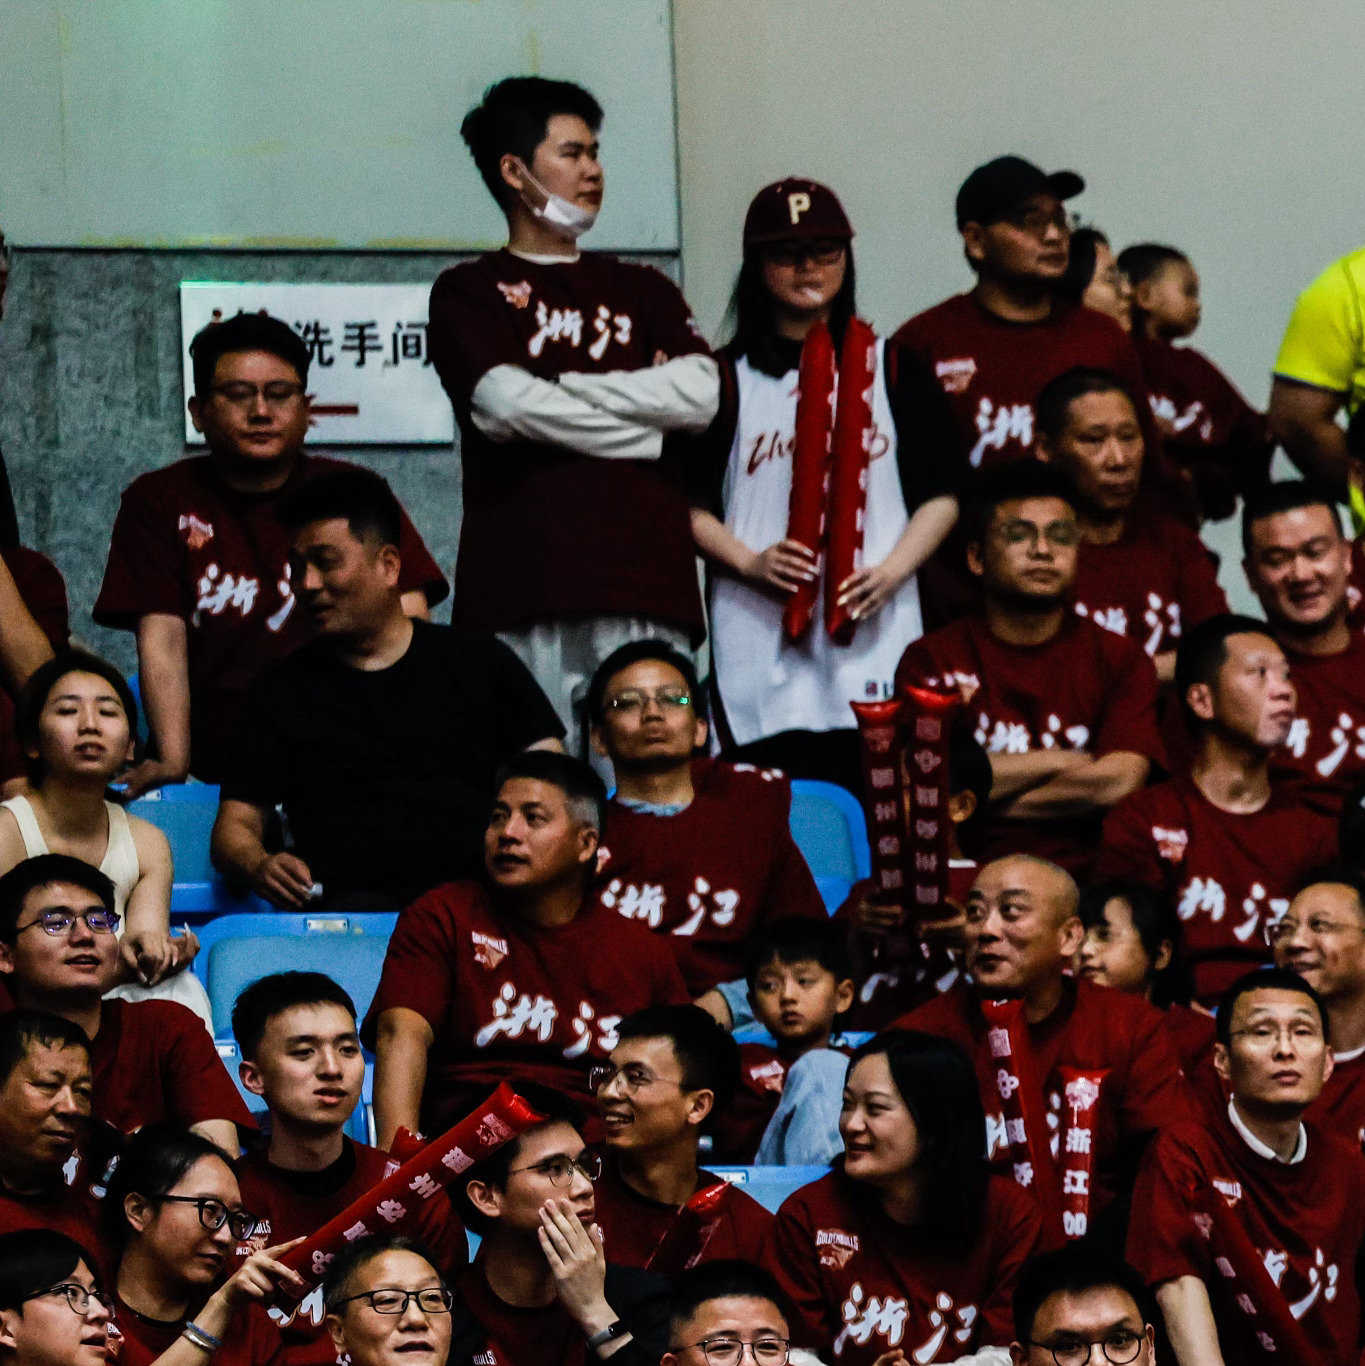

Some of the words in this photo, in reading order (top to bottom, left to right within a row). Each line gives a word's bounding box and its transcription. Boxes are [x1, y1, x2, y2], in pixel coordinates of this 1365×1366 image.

[788, 193, 812, 225] P
[970, 397, 1034, 468] 浙
[601, 876, 741, 936] 浙江
[475, 980, 621, 1061] 浙江
[833, 1281, 978, 1364] 浙江
